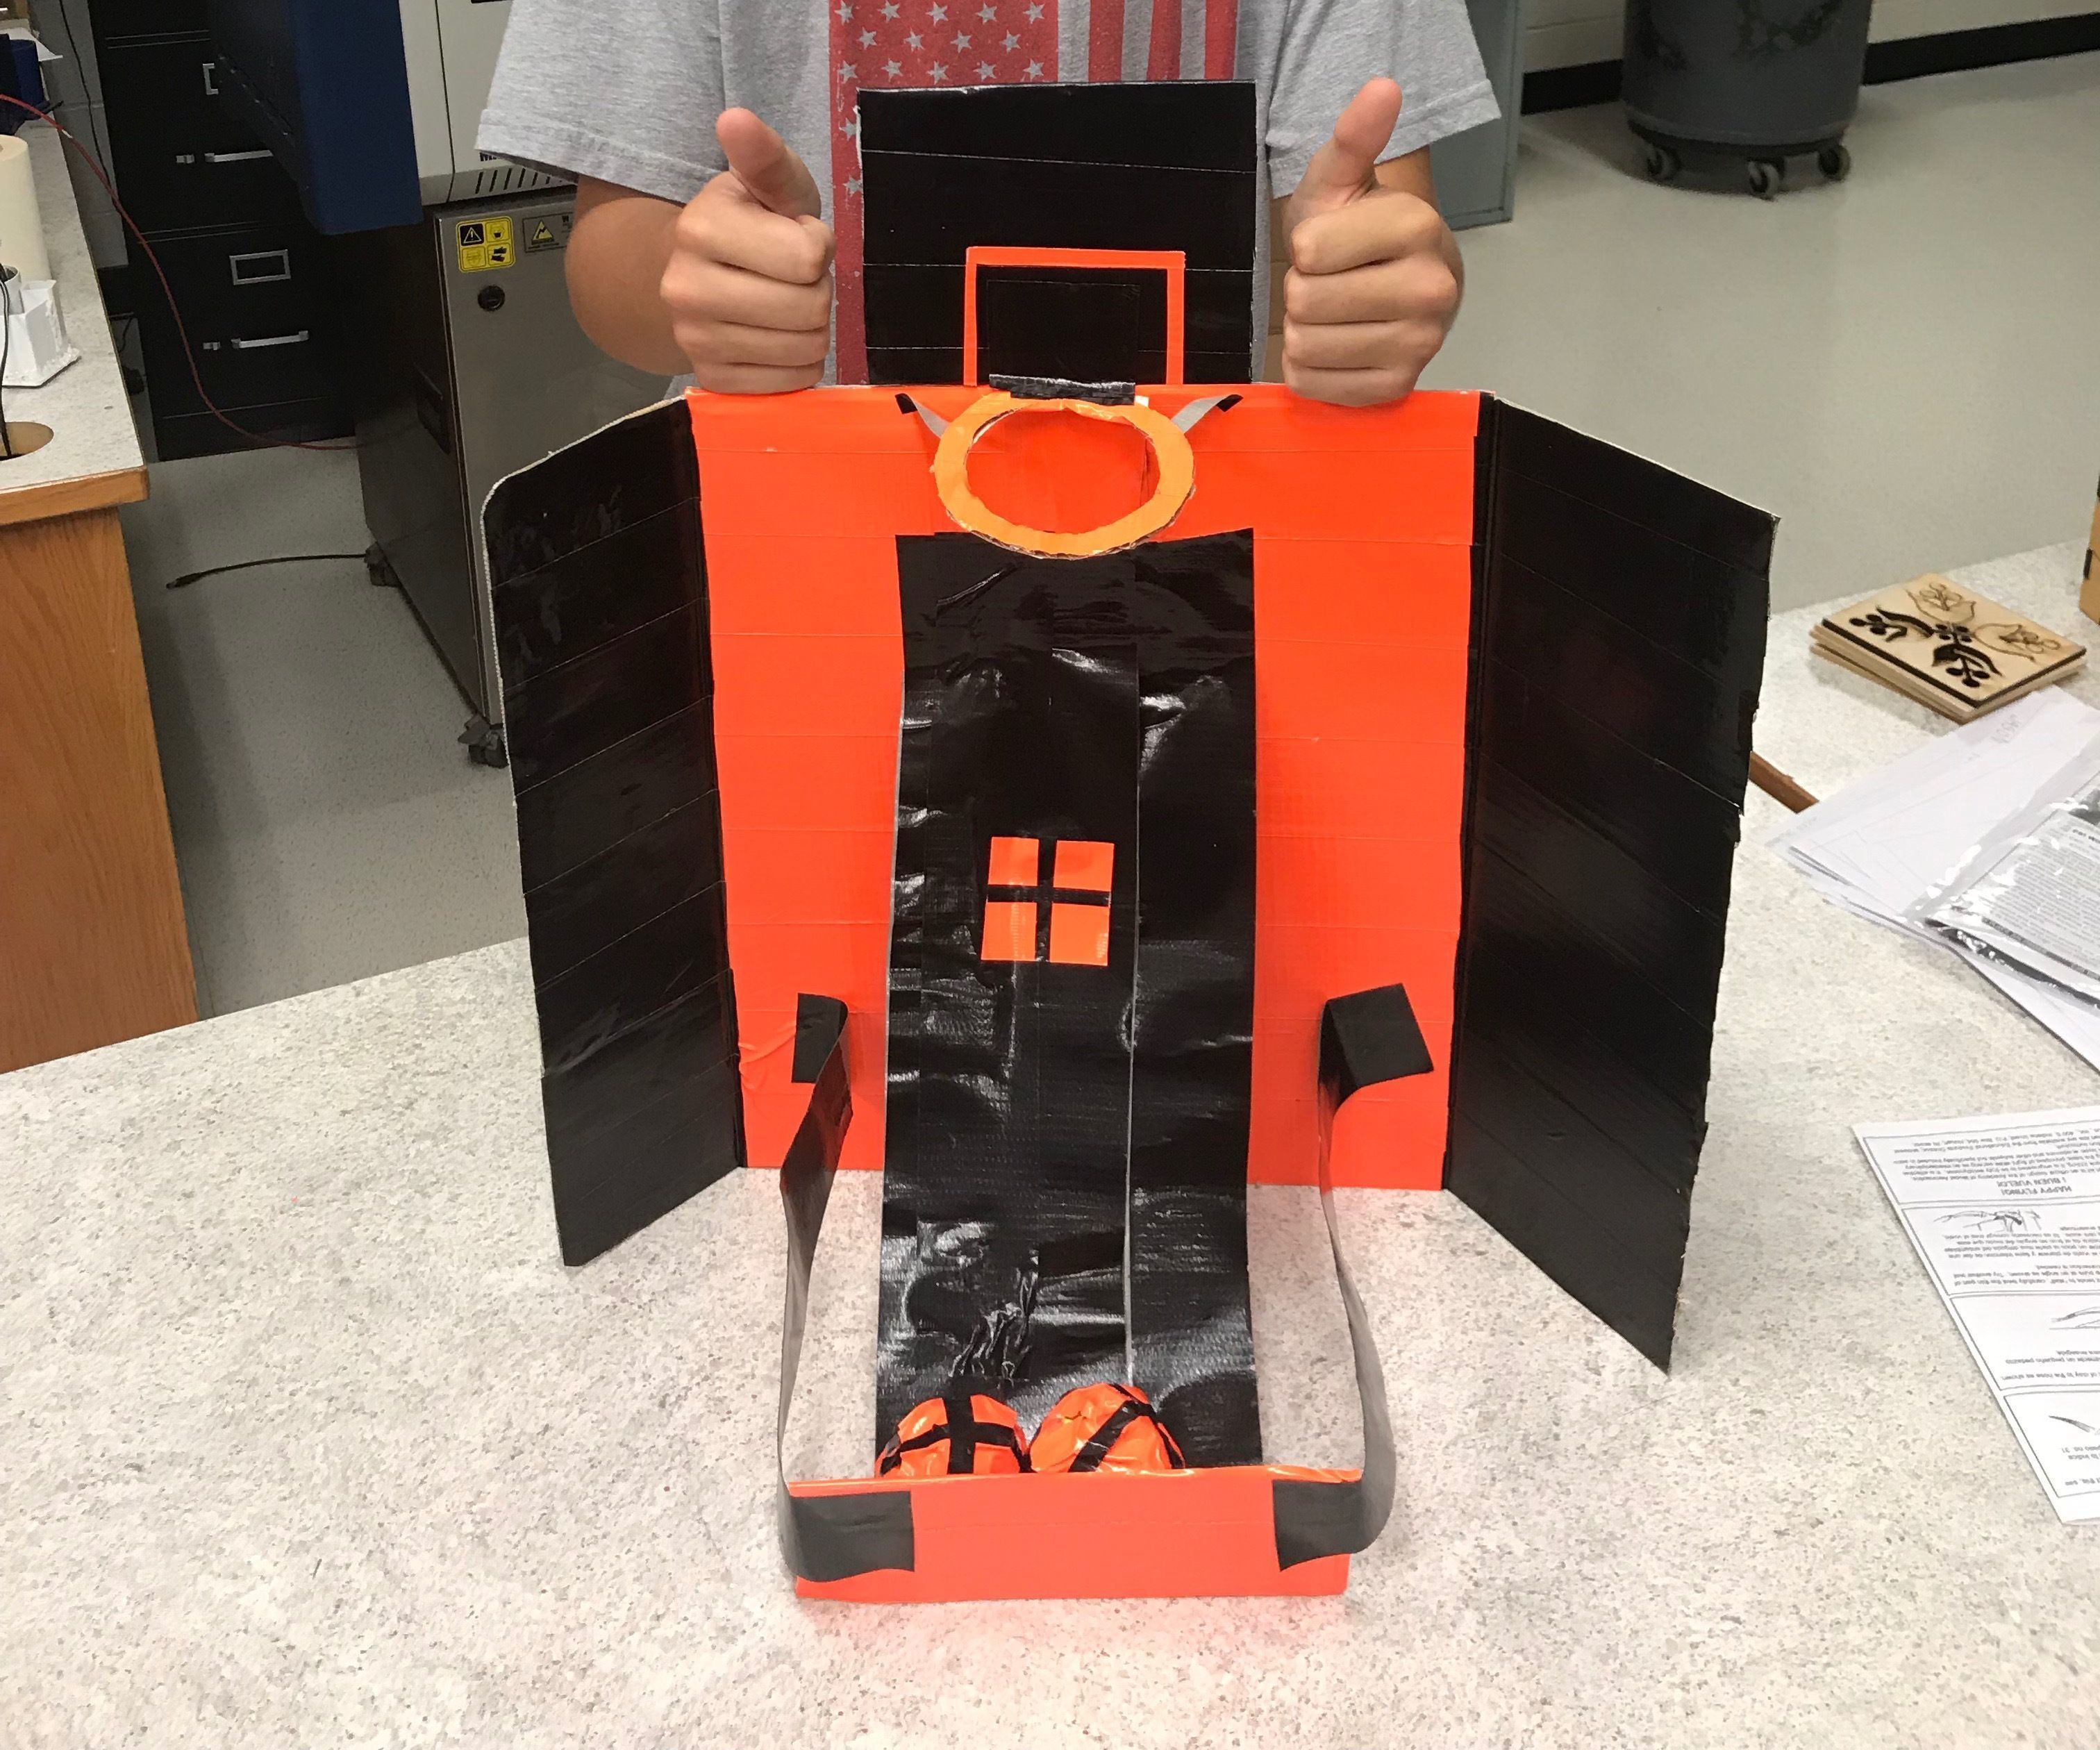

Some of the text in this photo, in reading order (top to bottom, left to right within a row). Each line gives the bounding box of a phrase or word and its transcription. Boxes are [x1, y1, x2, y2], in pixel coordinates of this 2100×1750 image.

[2033, 1177, 2061, 1185] BUEN
[2001, 1185, 2072, 1196] HAPPY FLYING!
